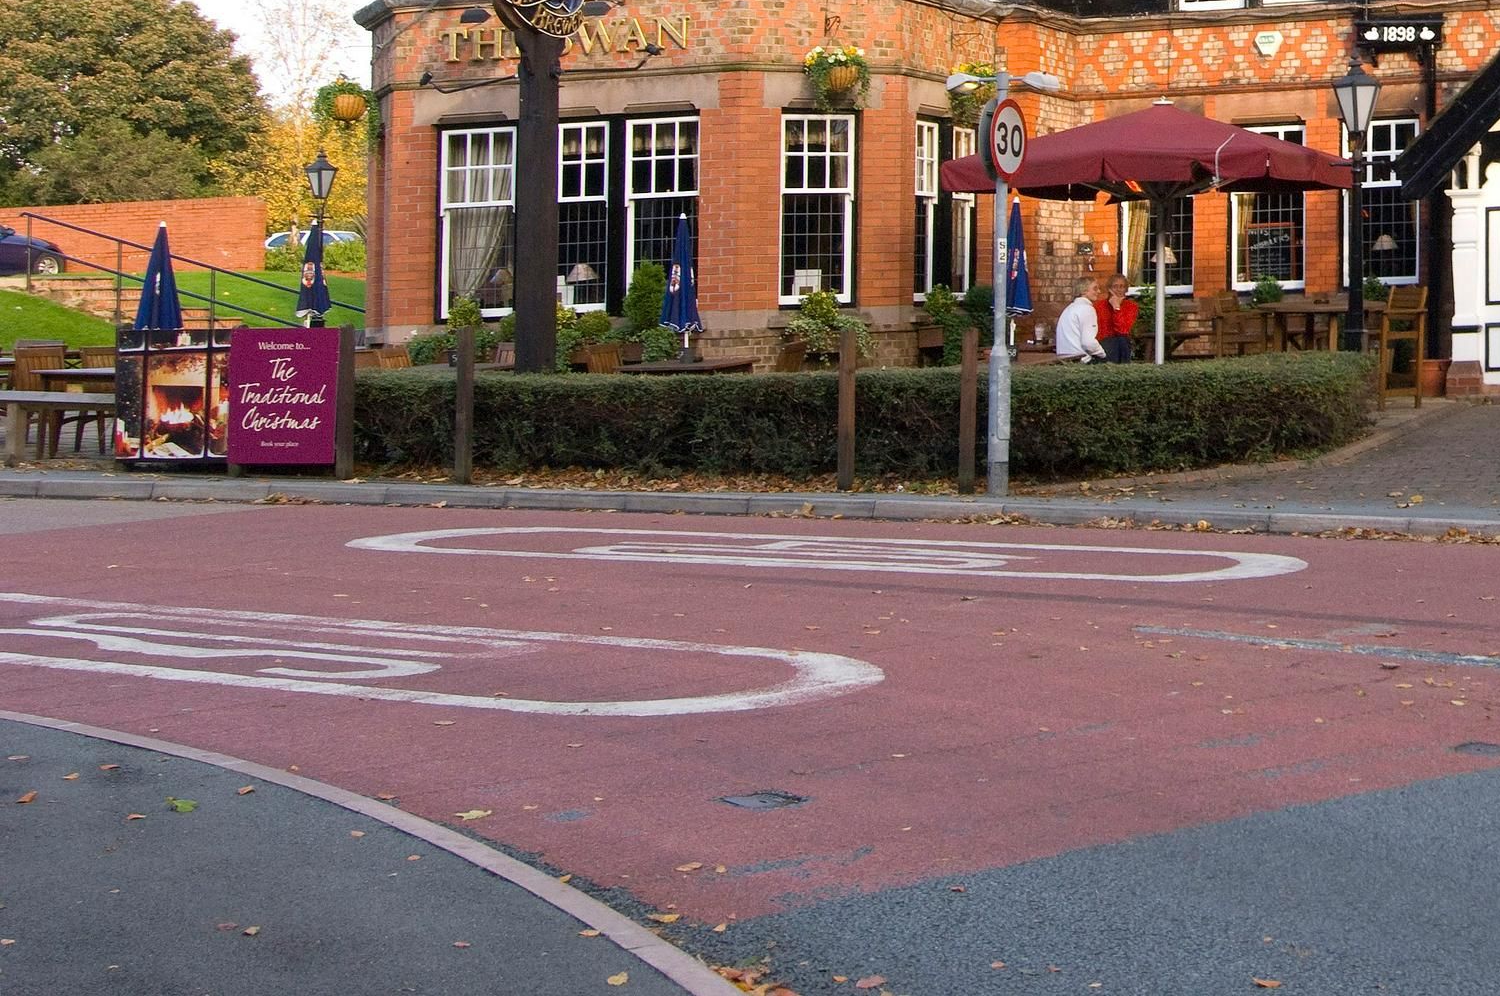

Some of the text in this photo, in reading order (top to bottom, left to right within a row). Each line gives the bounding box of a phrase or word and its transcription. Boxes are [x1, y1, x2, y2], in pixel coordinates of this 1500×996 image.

[531, 4, 585, 35] BREWER
[560, 14, 691, 57] WAN
[1383, 25, 1416, 42] 1898
[996, 121, 1023, 158] 30
[258, 342, 295, 350] Welcome
[269, 357, 298, 382] The
[238, 383, 327, 405] Traditional
[241, 406, 321, 432] Christmas
